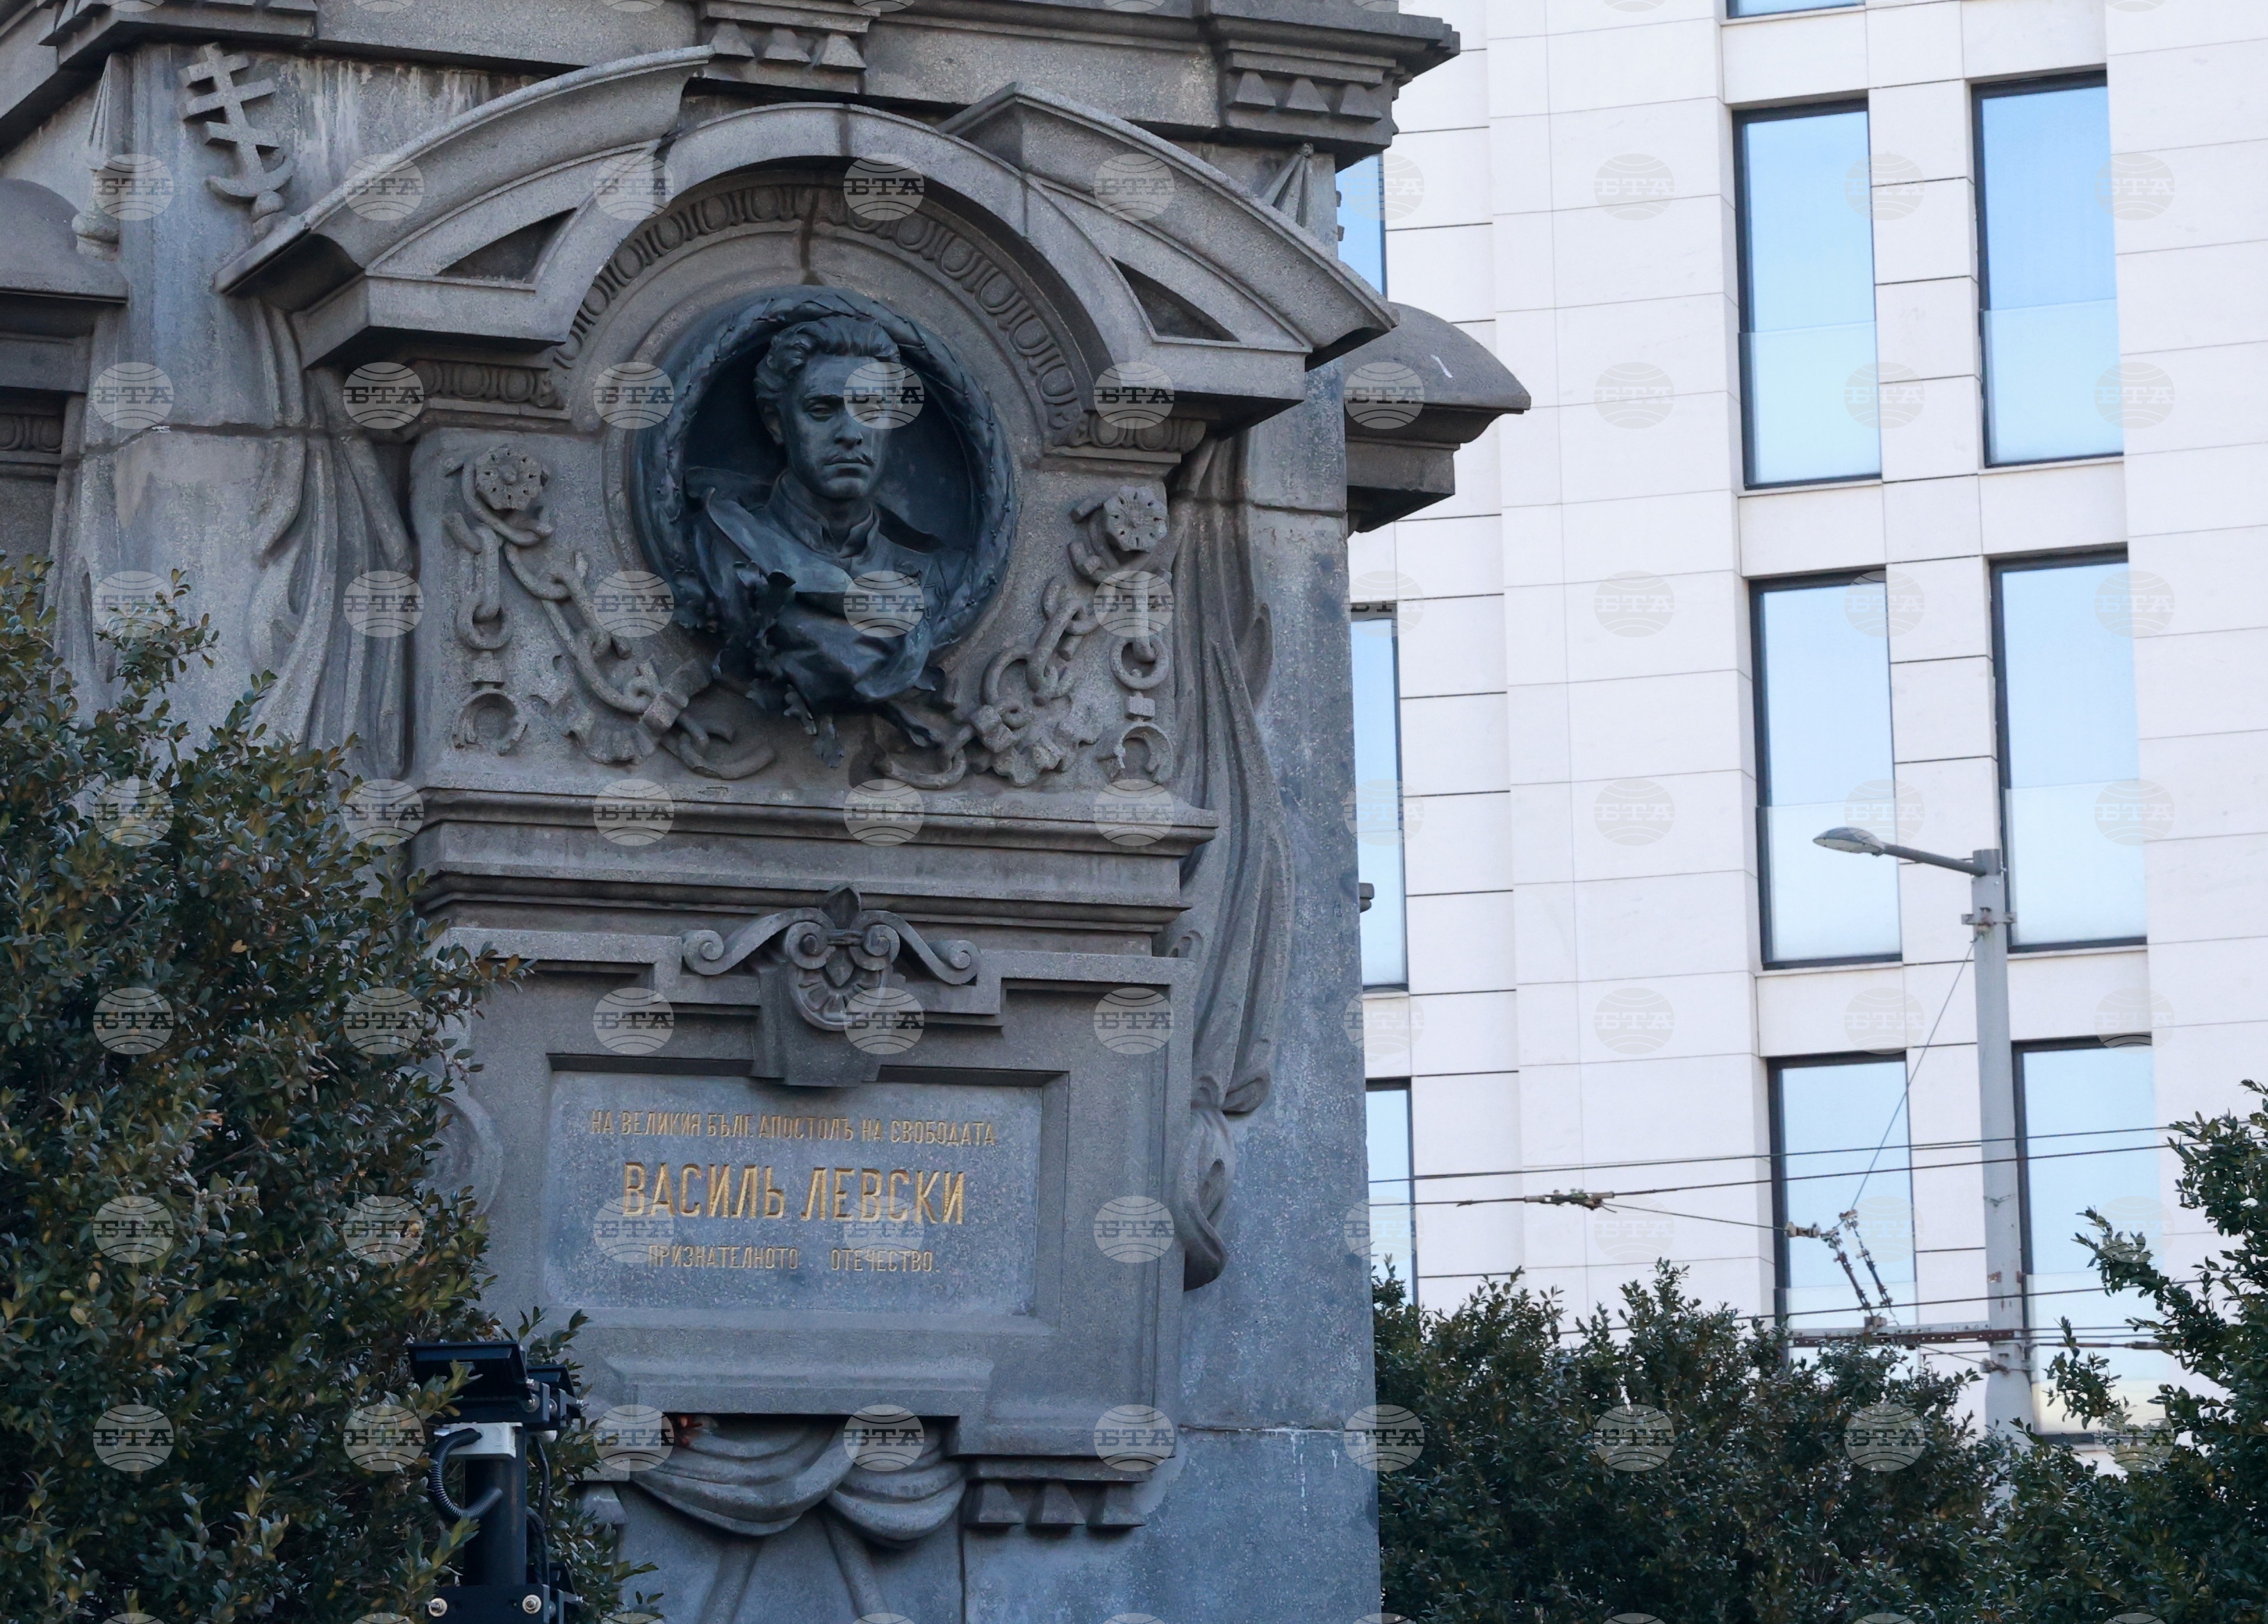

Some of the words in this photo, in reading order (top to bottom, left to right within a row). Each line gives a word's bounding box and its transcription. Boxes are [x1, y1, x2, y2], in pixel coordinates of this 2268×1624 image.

[591, 1110, 614, 1135] НА
[622, 1110, 701, 1137] ВЕЛИКИЯ
[707, 1113, 754, 1138] БЪЛГ.
[759, 1115, 854, 1141] АПОСТОЛЪ
[862, 1118, 883, 1142] НА
[890, 1119, 996, 1147] СВОБОДАТА
[623, 1162, 785, 1219] ВАСИЛЬ
[800, 1167, 965, 1225] ЛЕВСКИ
[648, 1245, 799, 1270] ПРИЗНАТЕЛНОТО
[831, 1247, 940, 1273] ОТЕЧЕСТВО.
